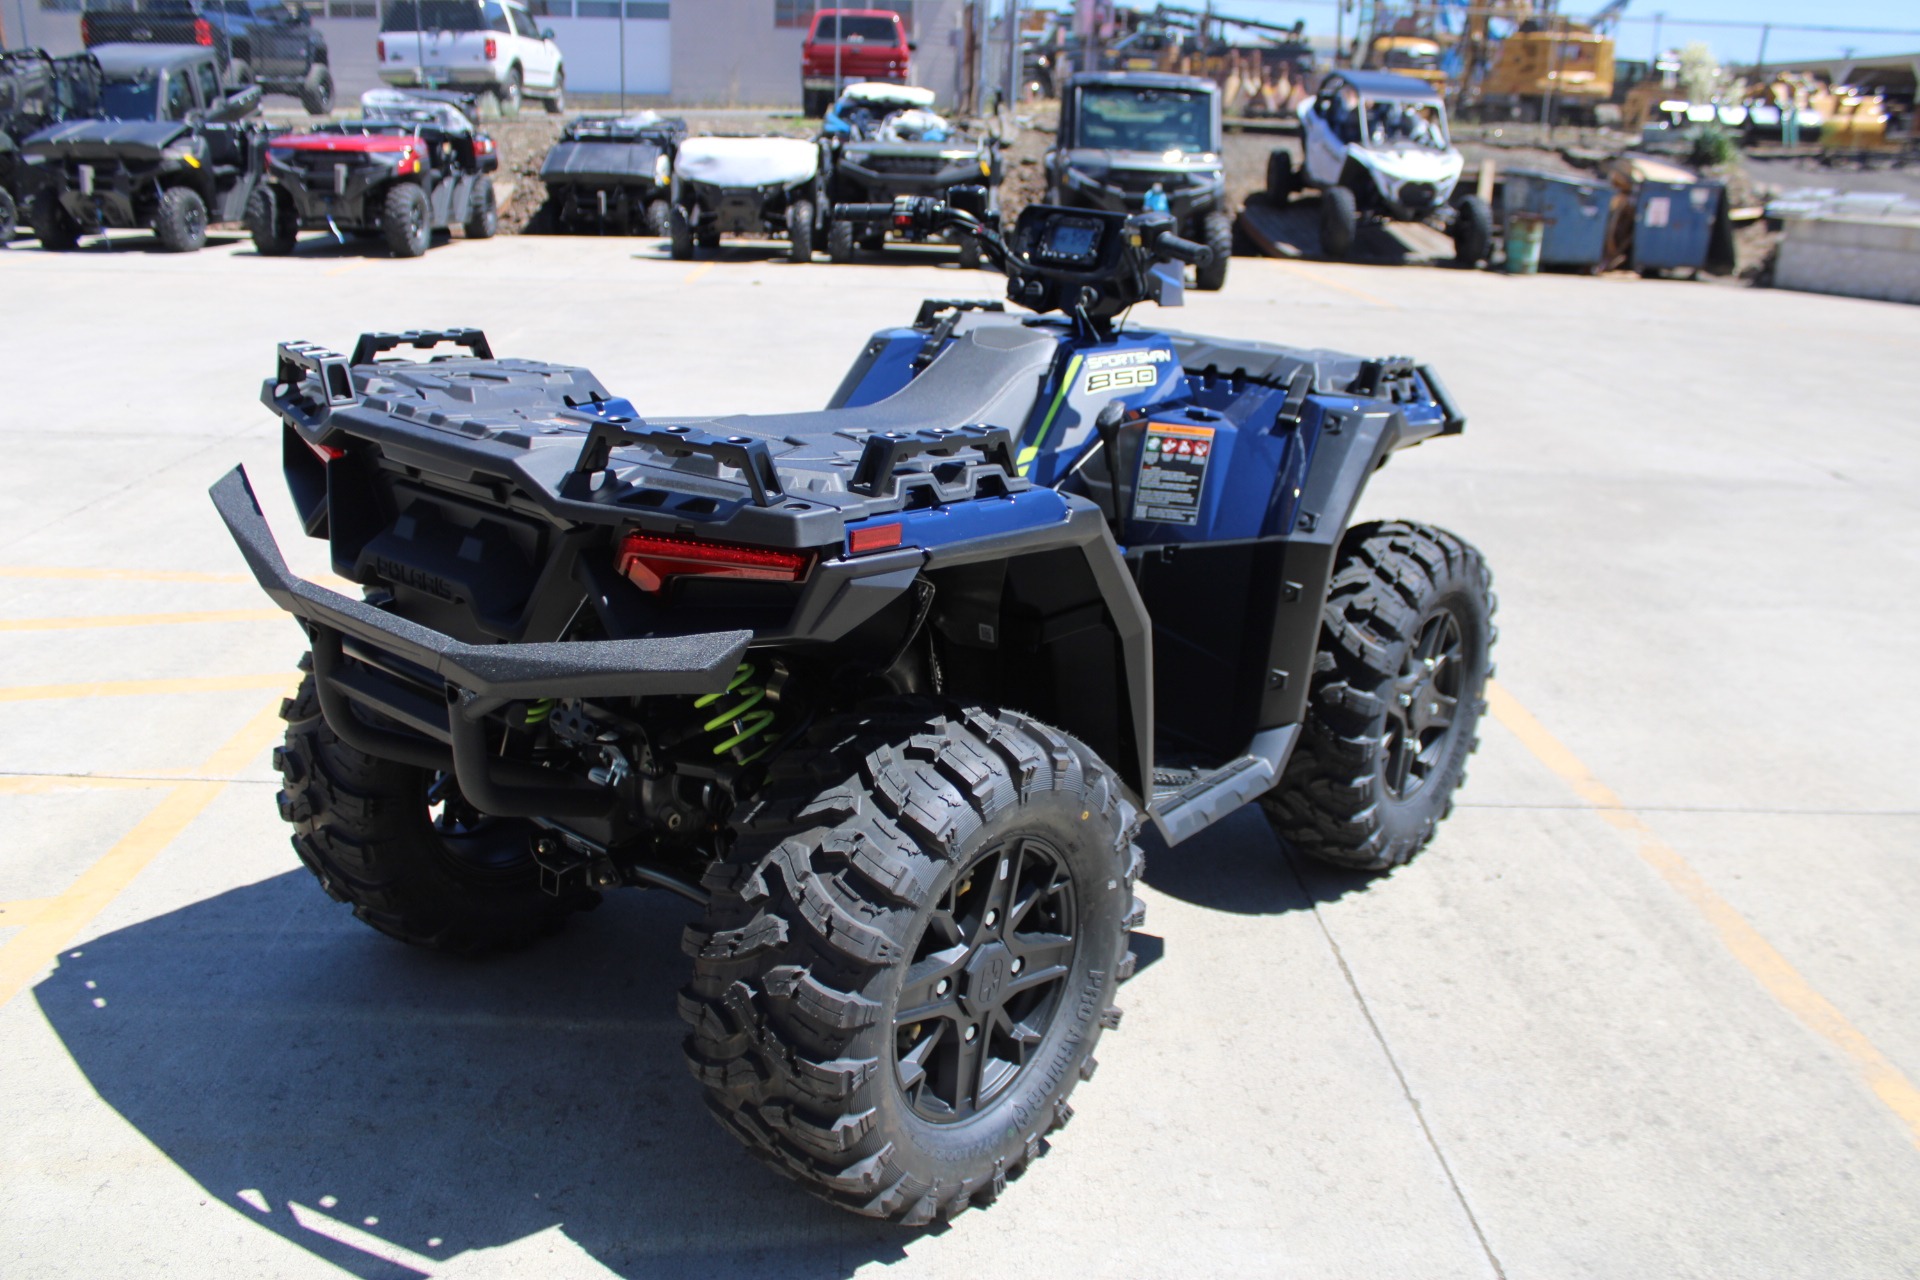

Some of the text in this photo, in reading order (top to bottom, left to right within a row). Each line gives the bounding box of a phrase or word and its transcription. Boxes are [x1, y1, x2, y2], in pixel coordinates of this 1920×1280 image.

[1087, 349, 1171, 370] SPORTSMAN
[1085, 365, 1157, 395] 850
[376, 556, 452, 600] POLARIS
[1026, 970, 1106, 1112] PRO ARMOR
